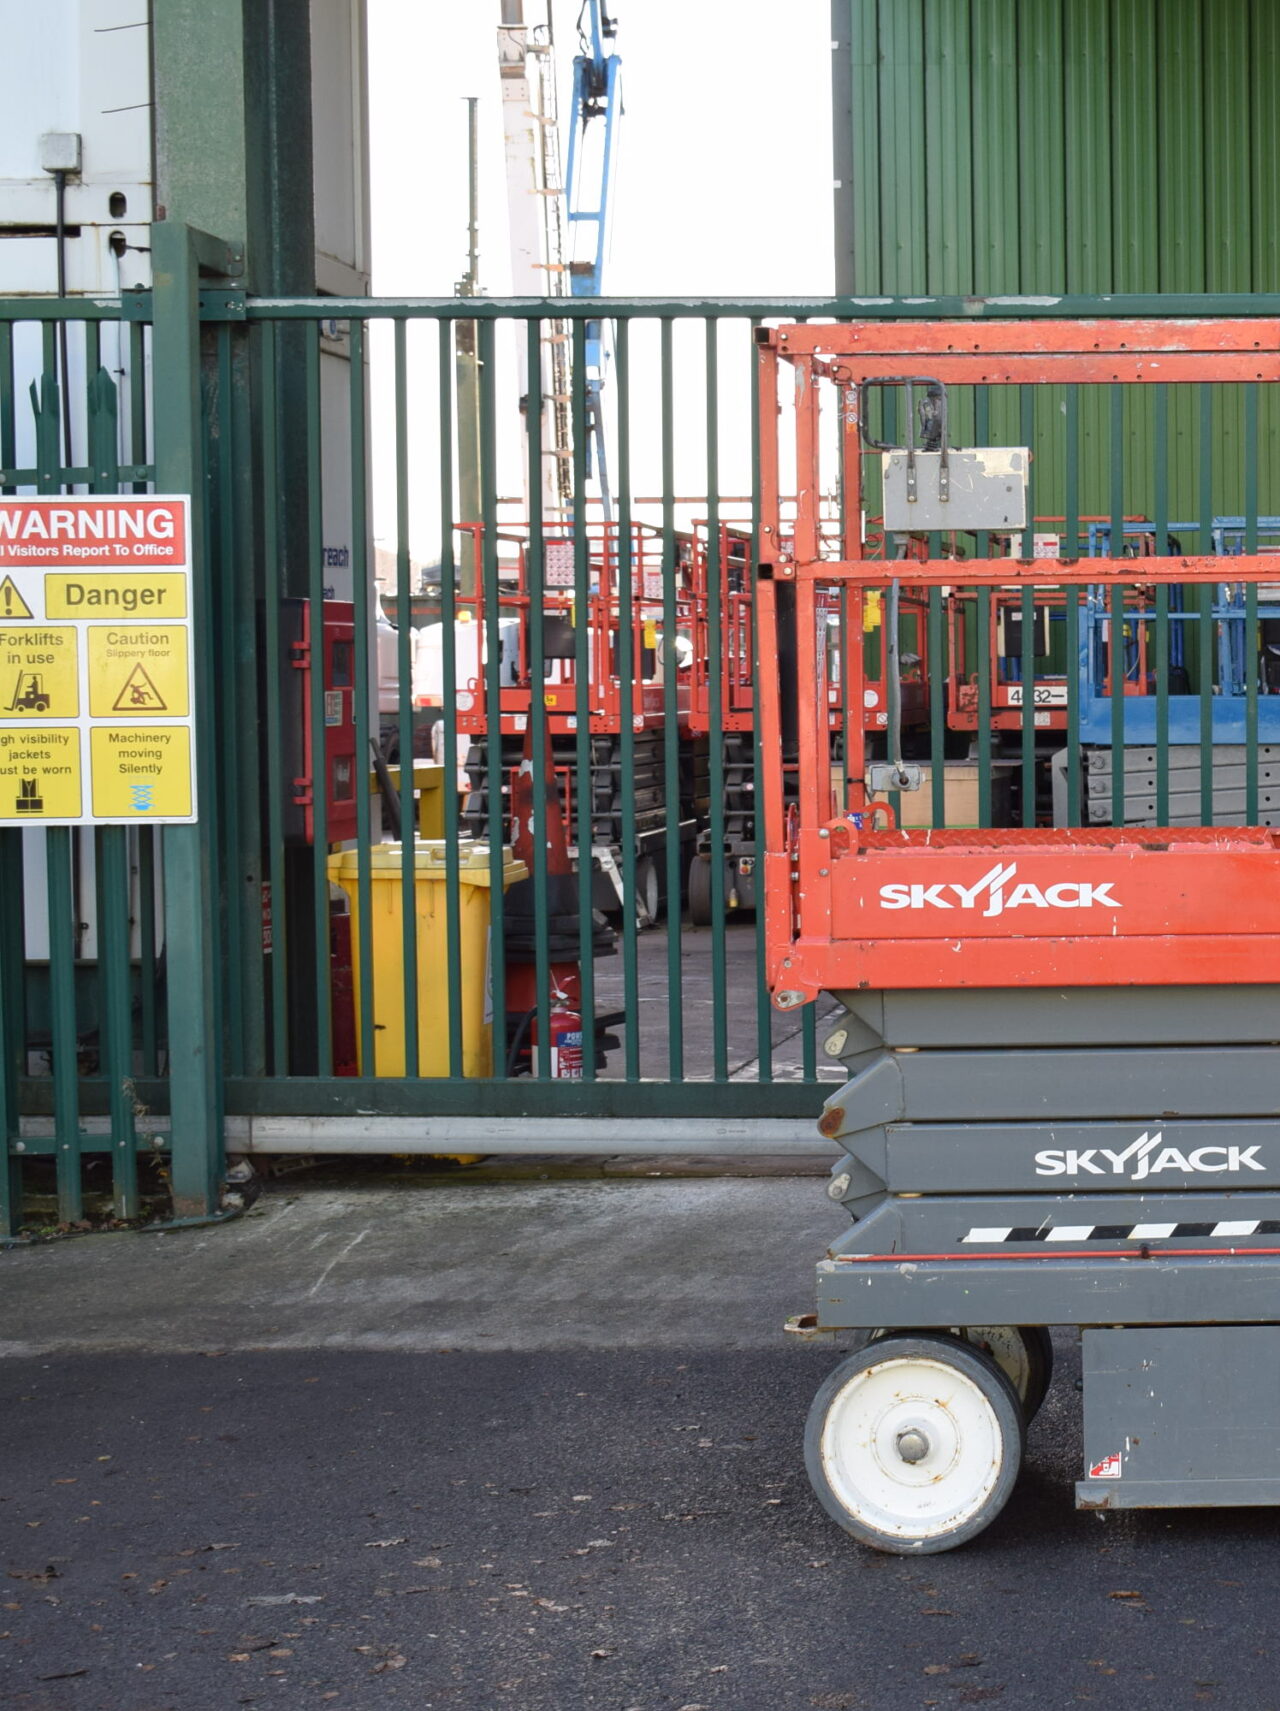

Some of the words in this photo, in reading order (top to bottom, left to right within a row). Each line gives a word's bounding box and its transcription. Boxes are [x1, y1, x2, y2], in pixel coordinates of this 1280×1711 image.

[8, 545, 59, 557] Visitors
[63, 544, 110, 558] Report
[113, 544, 129, 556] To
[133, 543, 173, 556] Office
[66, 583, 167, 611] Danger
[106, 632, 169, 645] Caution
[7, 653, 21, 664] in
[27, 655, 55, 664] use
[106, 650, 145, 659] Slippery
[148, 649, 170, 657] floor
[20, 734, 69, 746] visibility
[109, 733, 171, 744] Machinery
[9, 750, 51, 760] jackets
[118, 749, 162, 759] moving
[23, 765, 37, 775] be
[42, 766, 72, 775] worn
[119, 763, 162, 775] Silently
[879, 862, 1123, 917] SKYJACK
[1035, 1131, 1266, 1180] SKYJACK
